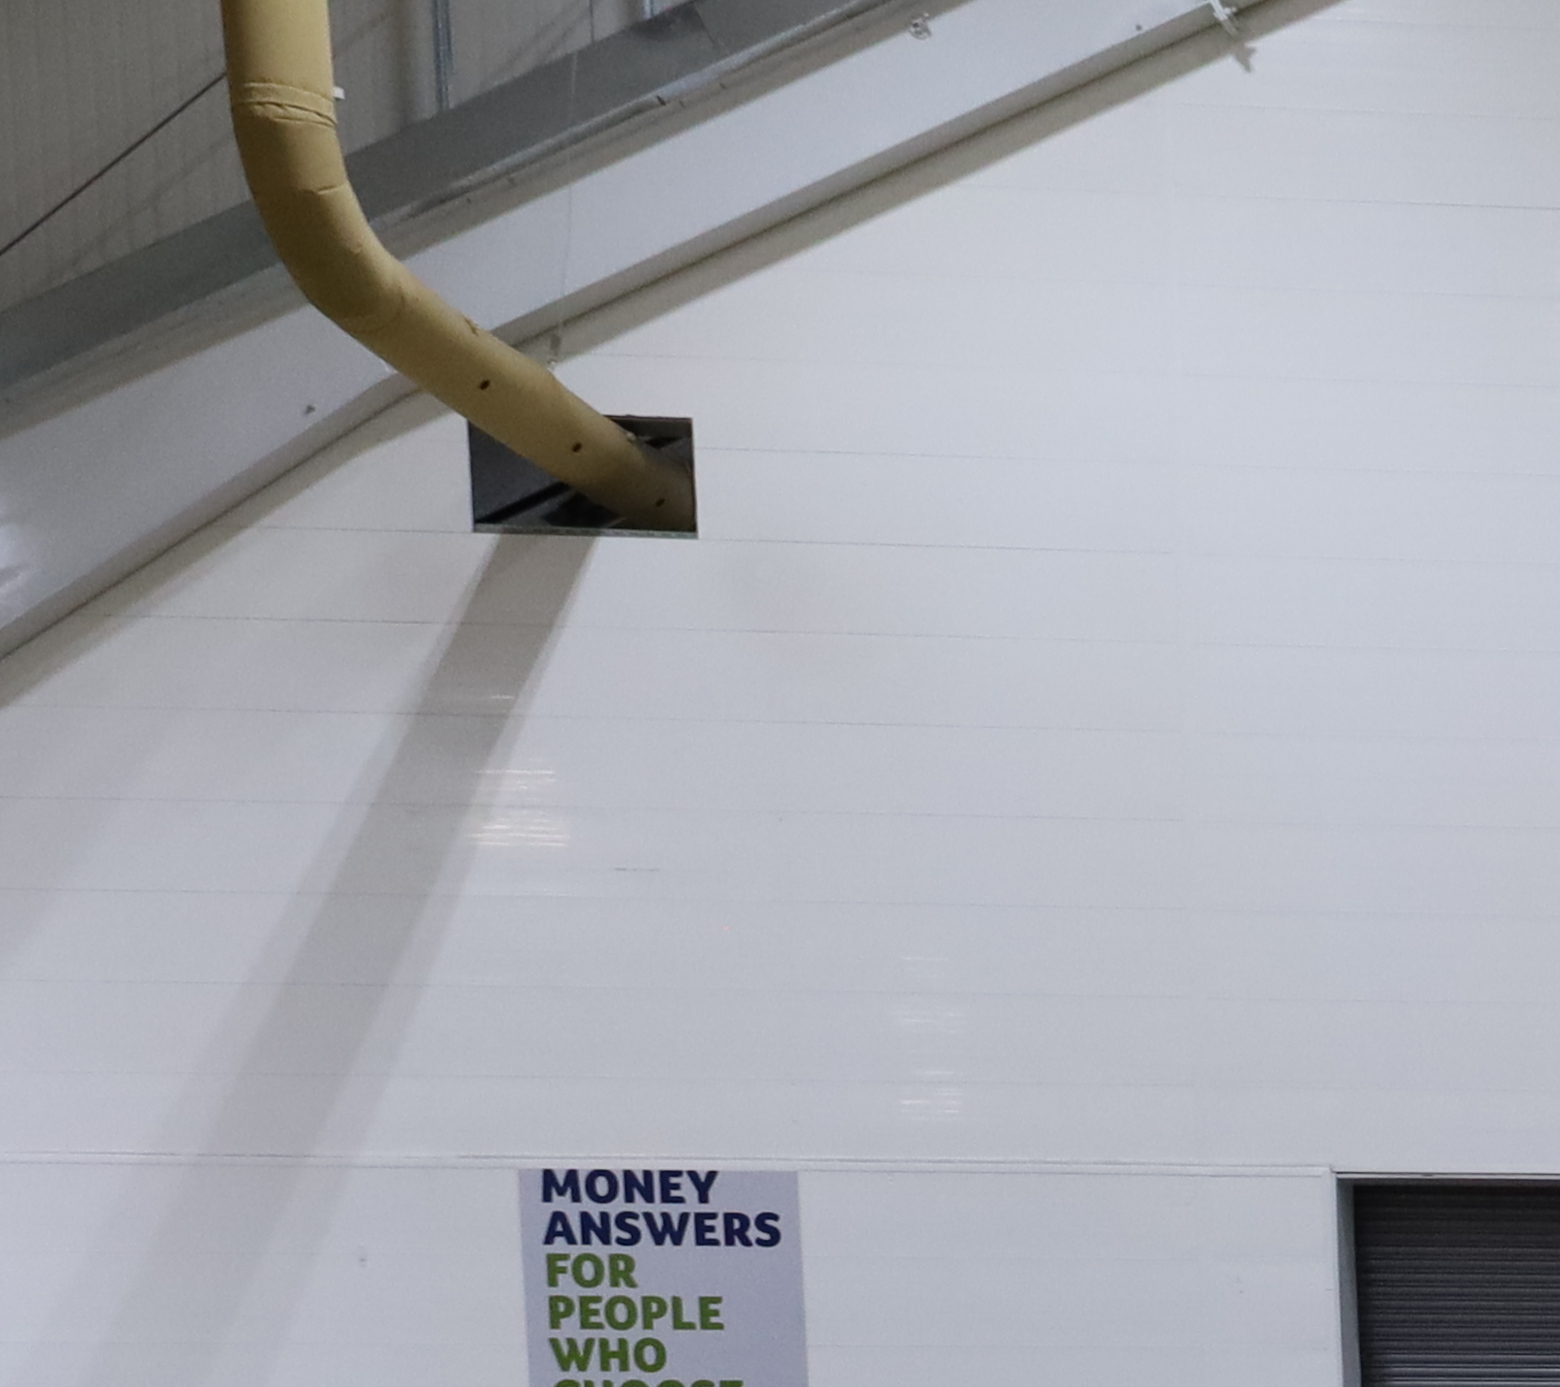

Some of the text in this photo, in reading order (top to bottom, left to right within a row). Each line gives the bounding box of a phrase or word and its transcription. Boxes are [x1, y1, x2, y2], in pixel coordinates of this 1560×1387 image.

[541, 1168, 719, 1204] MONEY
[543, 1210, 782, 1247] ANSWERS
[545, 1252, 639, 1289] FOR
[548, 1295, 725, 1331] PEOPLE
[549, 1337, 667, 1373] WHO
